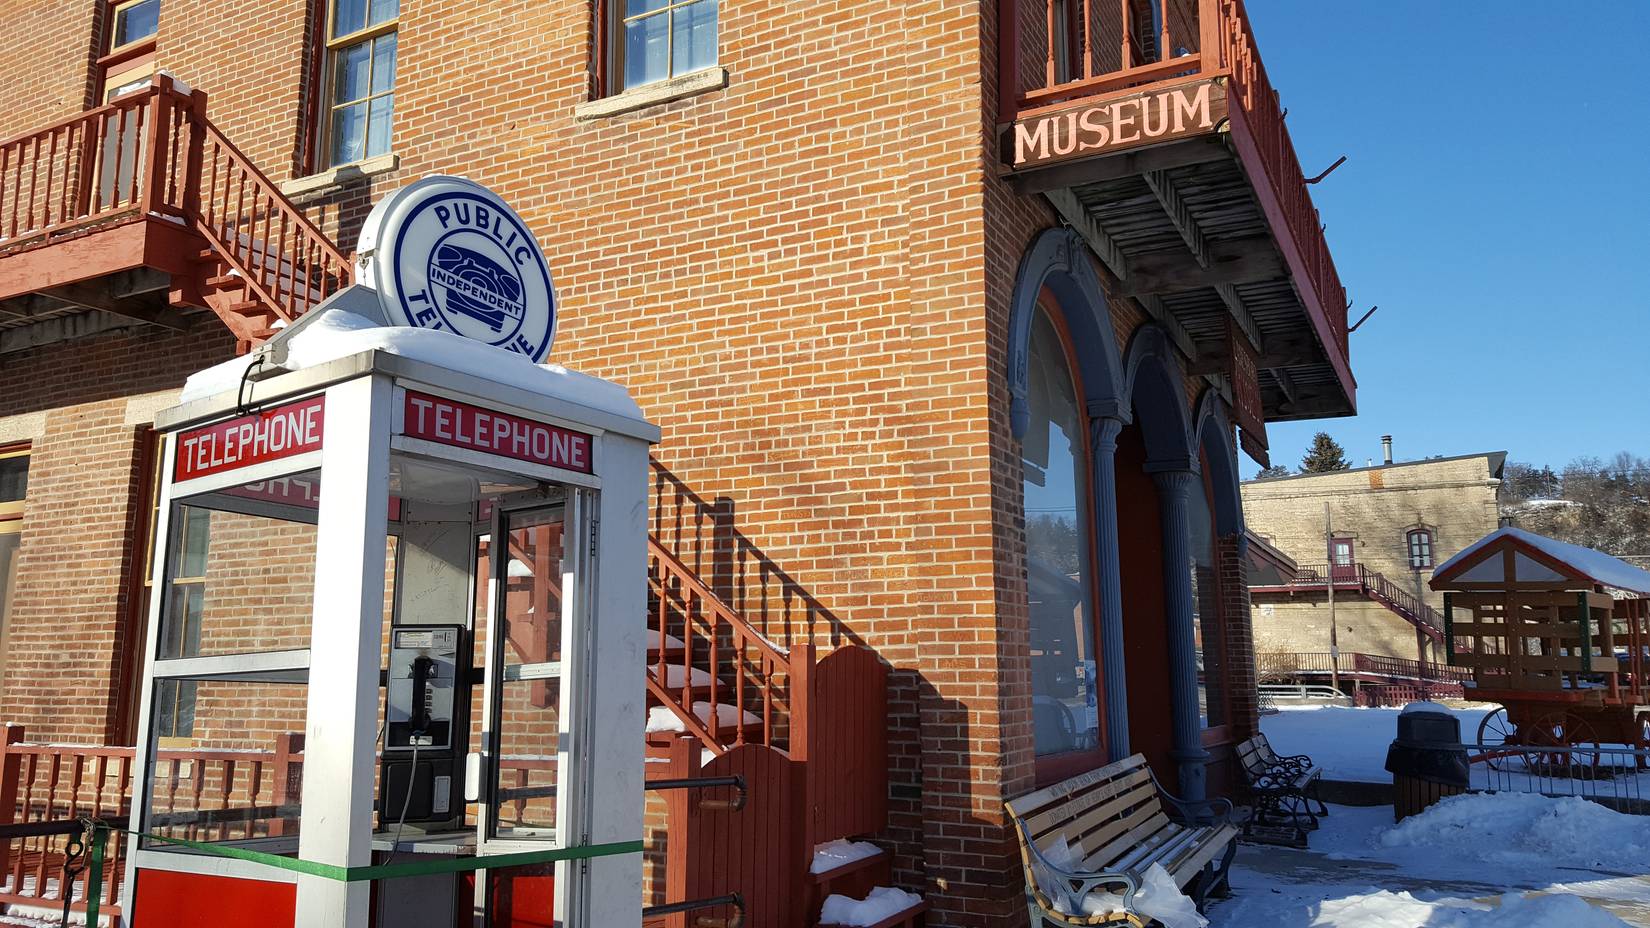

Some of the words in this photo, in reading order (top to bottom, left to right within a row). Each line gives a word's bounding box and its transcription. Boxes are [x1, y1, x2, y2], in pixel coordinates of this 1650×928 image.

[1014, 83, 1213, 165] MUSEUM
[434, 202, 532, 266] PUBLIC
[431, 268, 522, 315] INDEPENDENT
[184, 404, 322, 473] TELEPHONE
[411, 397, 586, 468] TELEPHONE
